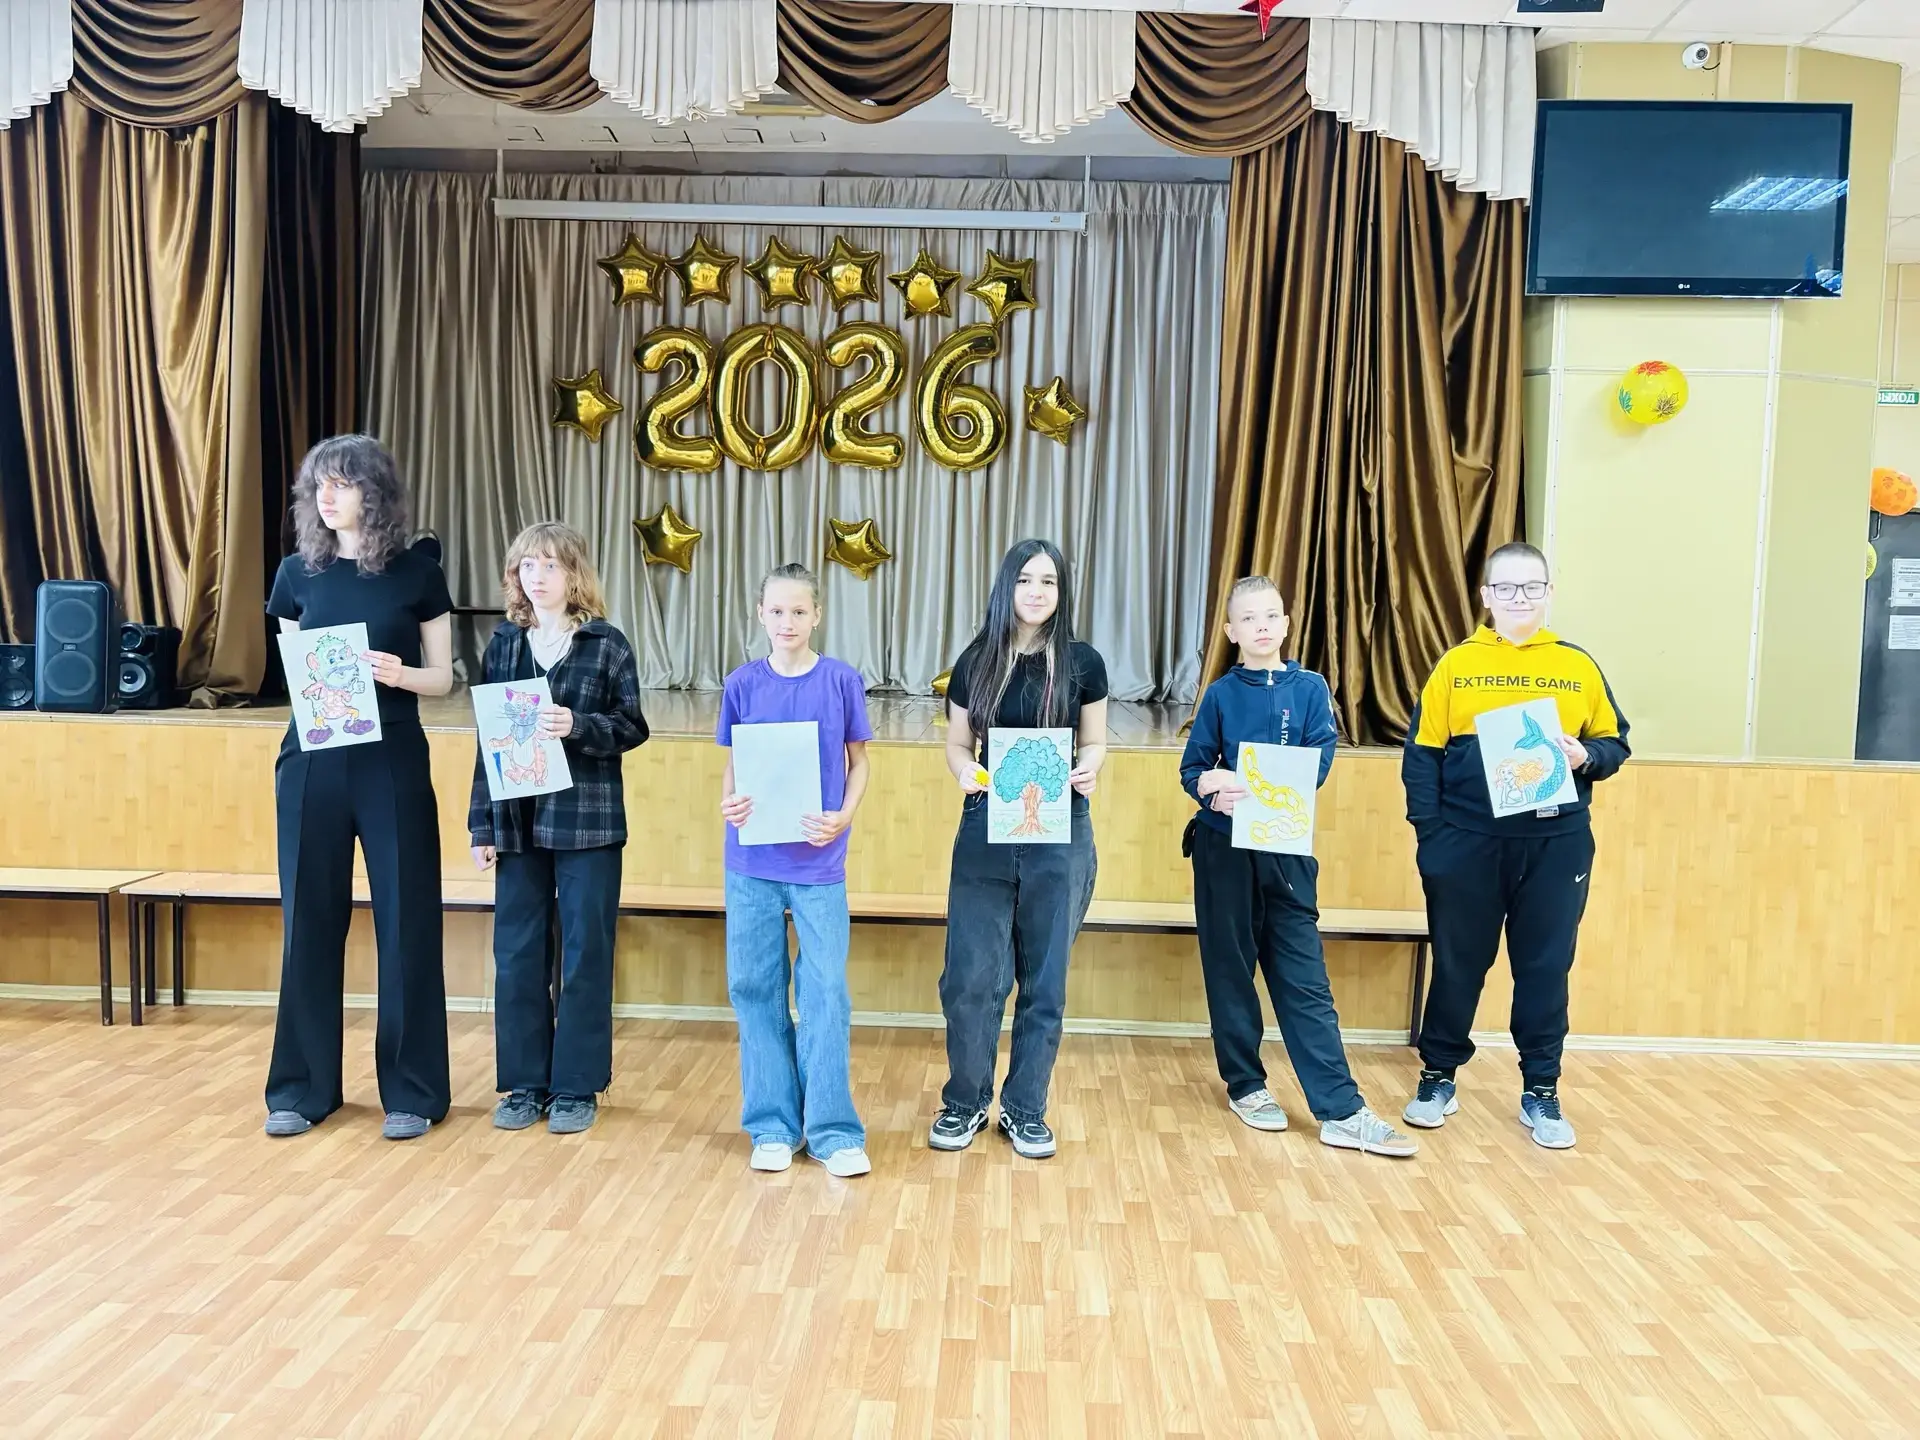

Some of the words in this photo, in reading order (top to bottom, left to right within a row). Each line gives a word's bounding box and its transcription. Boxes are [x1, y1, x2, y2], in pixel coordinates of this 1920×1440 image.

[633, 320, 1006, 472] 2026
[1454, 675, 1530, 688] EXTREME
[1535, 677, 1582, 692] GAME
[1281, 709, 1290, 730] FILA
